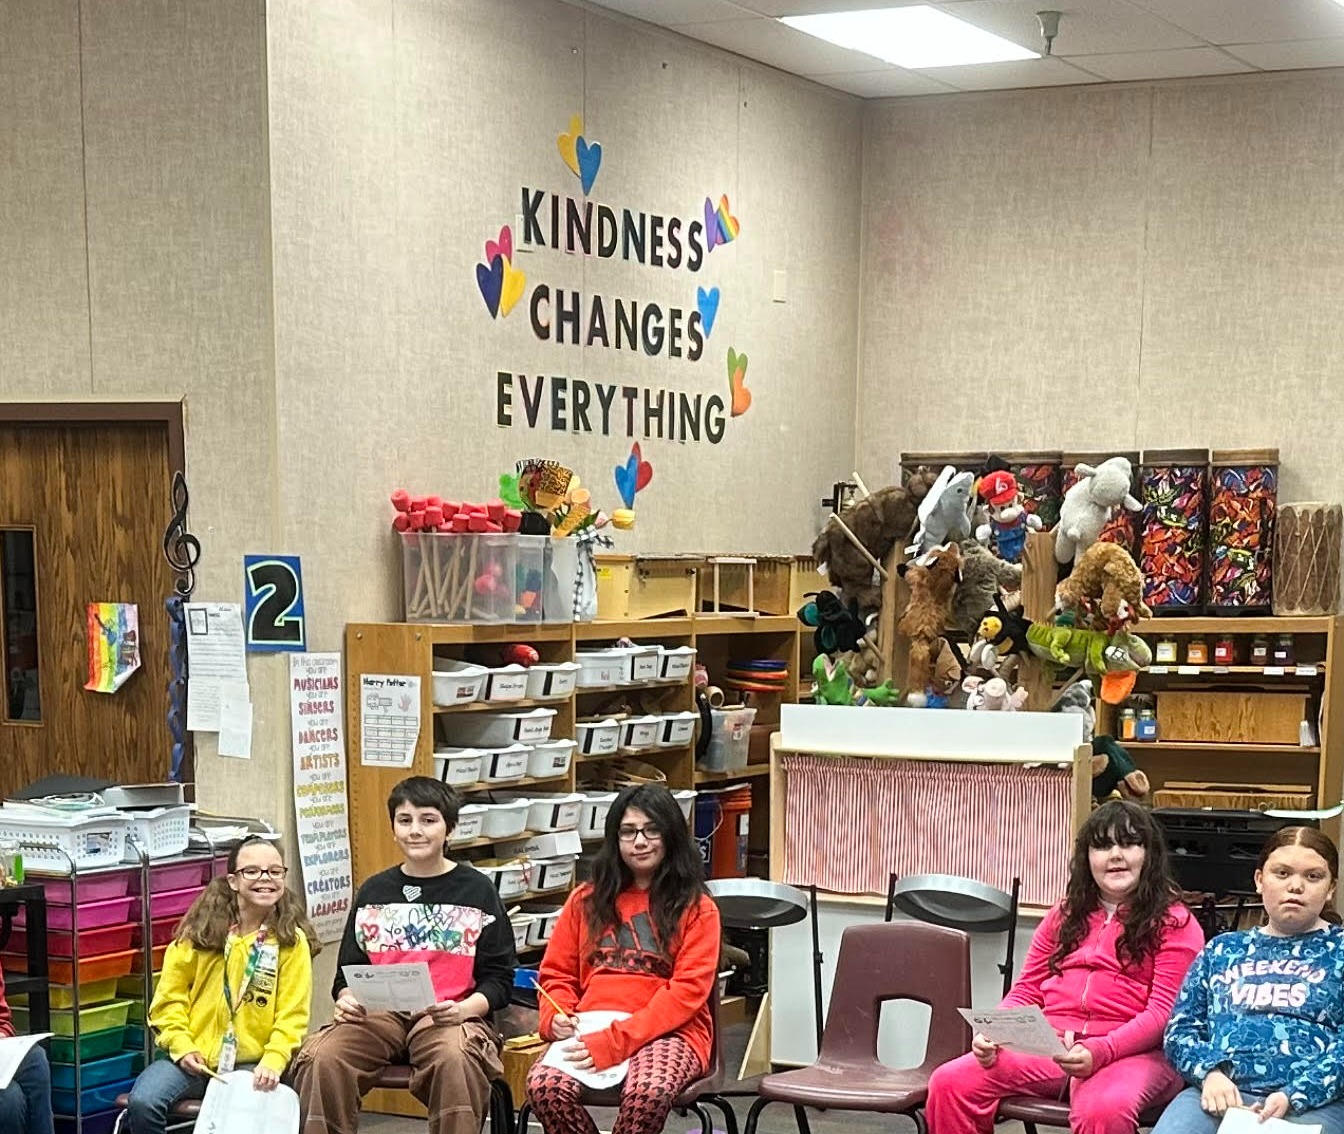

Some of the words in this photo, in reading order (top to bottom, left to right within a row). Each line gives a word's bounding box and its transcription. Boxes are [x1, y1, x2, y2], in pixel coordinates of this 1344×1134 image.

[521, 186, 704, 272] KINDNESS
[530, 283, 704, 361] CHANGES
[497, 371, 726, 444] EVERYTHING
[247, 560, 304, 646] 2
[293, 677, 339, 691] MUSICIANS
[363, 677, 385, 688] Harry
[387, 678, 406, 687] Potter
[300, 753, 340, 770] ARTISTS
[307, 875, 351, 895] CREATORS
[1230, 982, 1310, 1008] VIBES
